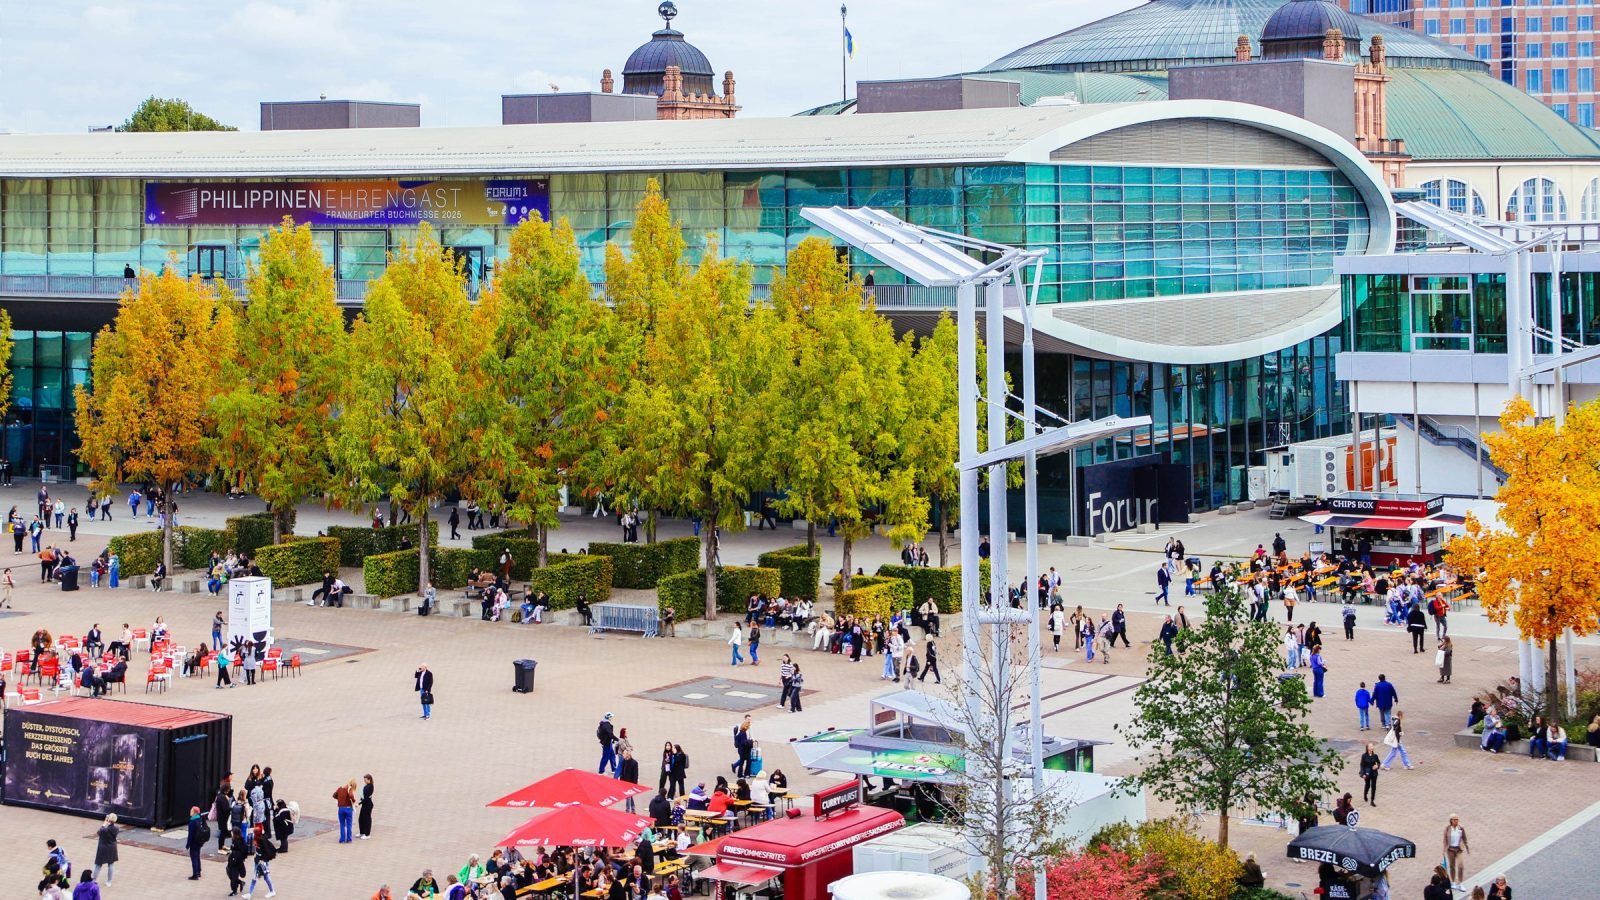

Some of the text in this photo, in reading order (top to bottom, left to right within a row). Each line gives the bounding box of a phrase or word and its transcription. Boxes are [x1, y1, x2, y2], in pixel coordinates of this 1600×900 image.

[200, 188, 461, 209] PHILIPPINEN EHRENGAST
[486, 187, 528, 198] FORUM 1
[326, 210, 462, 219] FRANKFURTER BUCHMESSE 2025
[1333, 500, 1356, 509] CHIPS
[1357, 501, 1374, 509] BOX
[21, 721, 80, 737] DÜSTER, DYSTOPISCH,
[24, 732, 73, 745] HERZZERREISSEND
[31, 742, 69, 754] DAS GRÖSSTE
[25, 751, 74, 764] BUCH DES JAHRES
[1300, 847, 1338, 865] BREZEL
